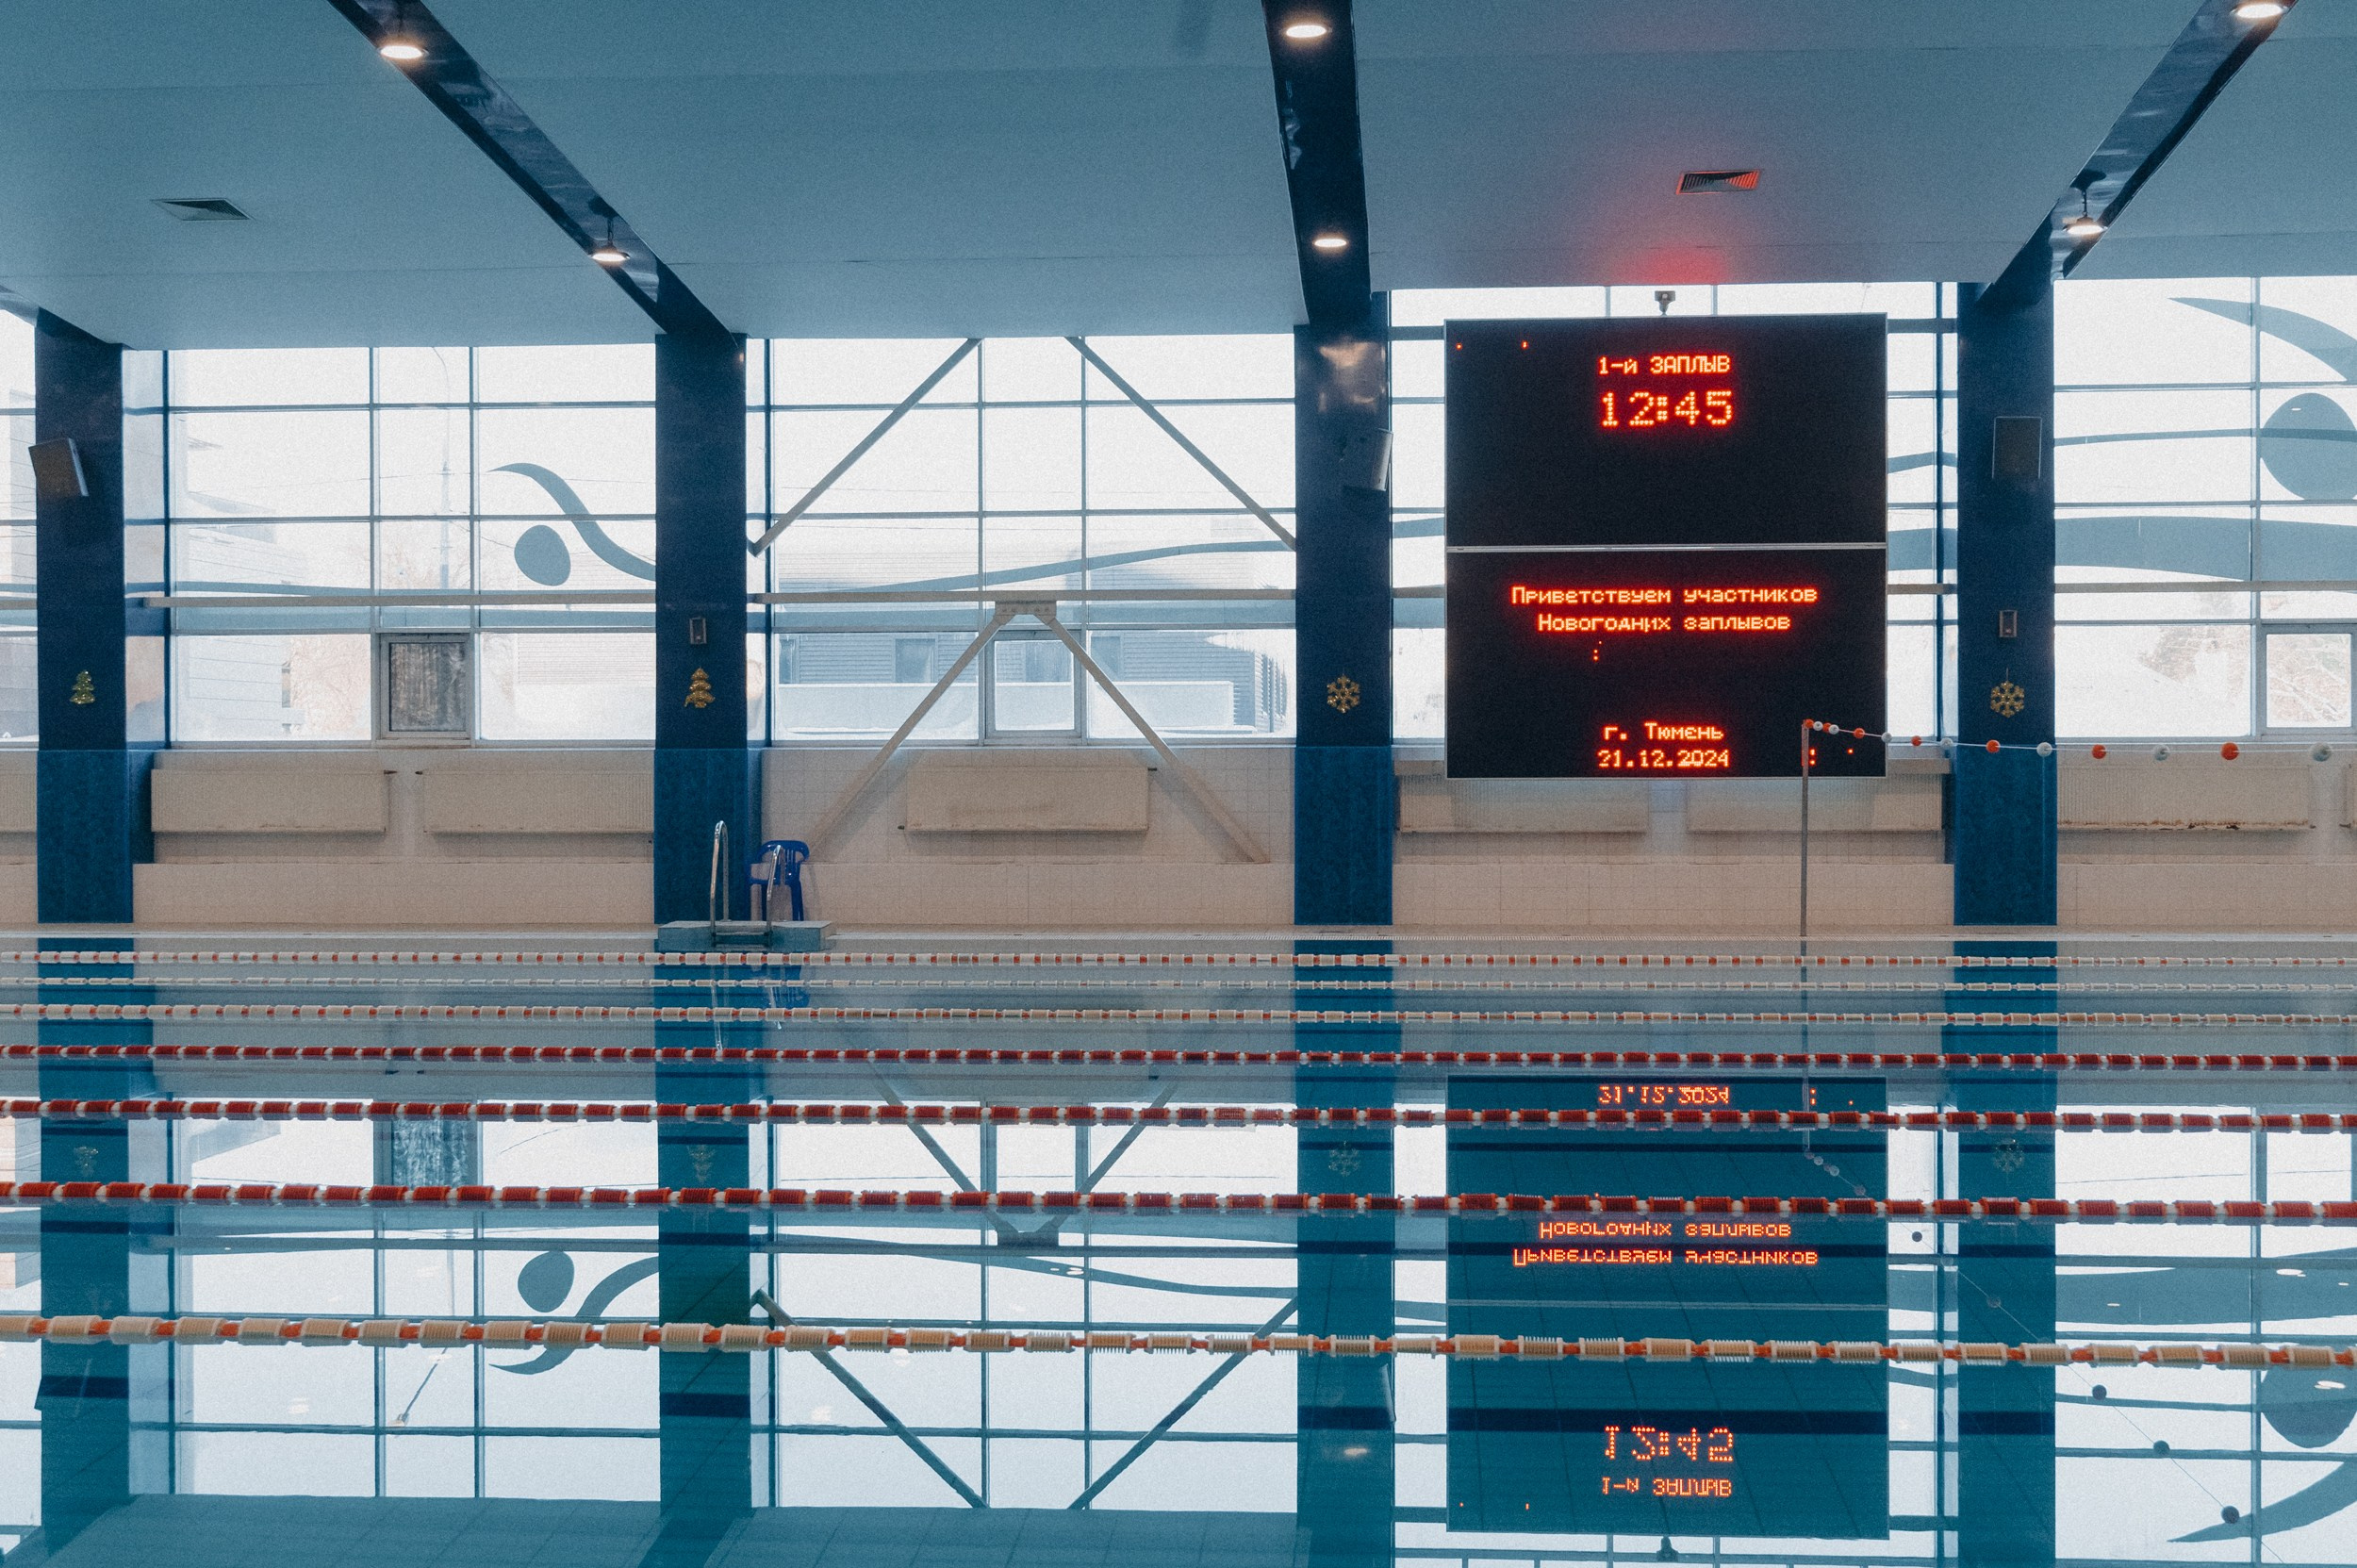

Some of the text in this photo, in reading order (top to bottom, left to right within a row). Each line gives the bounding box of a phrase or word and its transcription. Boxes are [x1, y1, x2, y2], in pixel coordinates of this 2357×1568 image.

[1649, 354, 1731, 375] ЗАПЛЫВ
[1601, 388, 1734, 428] 12:45
[1510, 585, 1818, 605] Приветствуем участников
[1537, 613, 1791, 634] Новогодних заплывов
[1603, 721, 1725, 742] г. Тюмень
[1597, 748, 1730, 768] 21.12.2024
